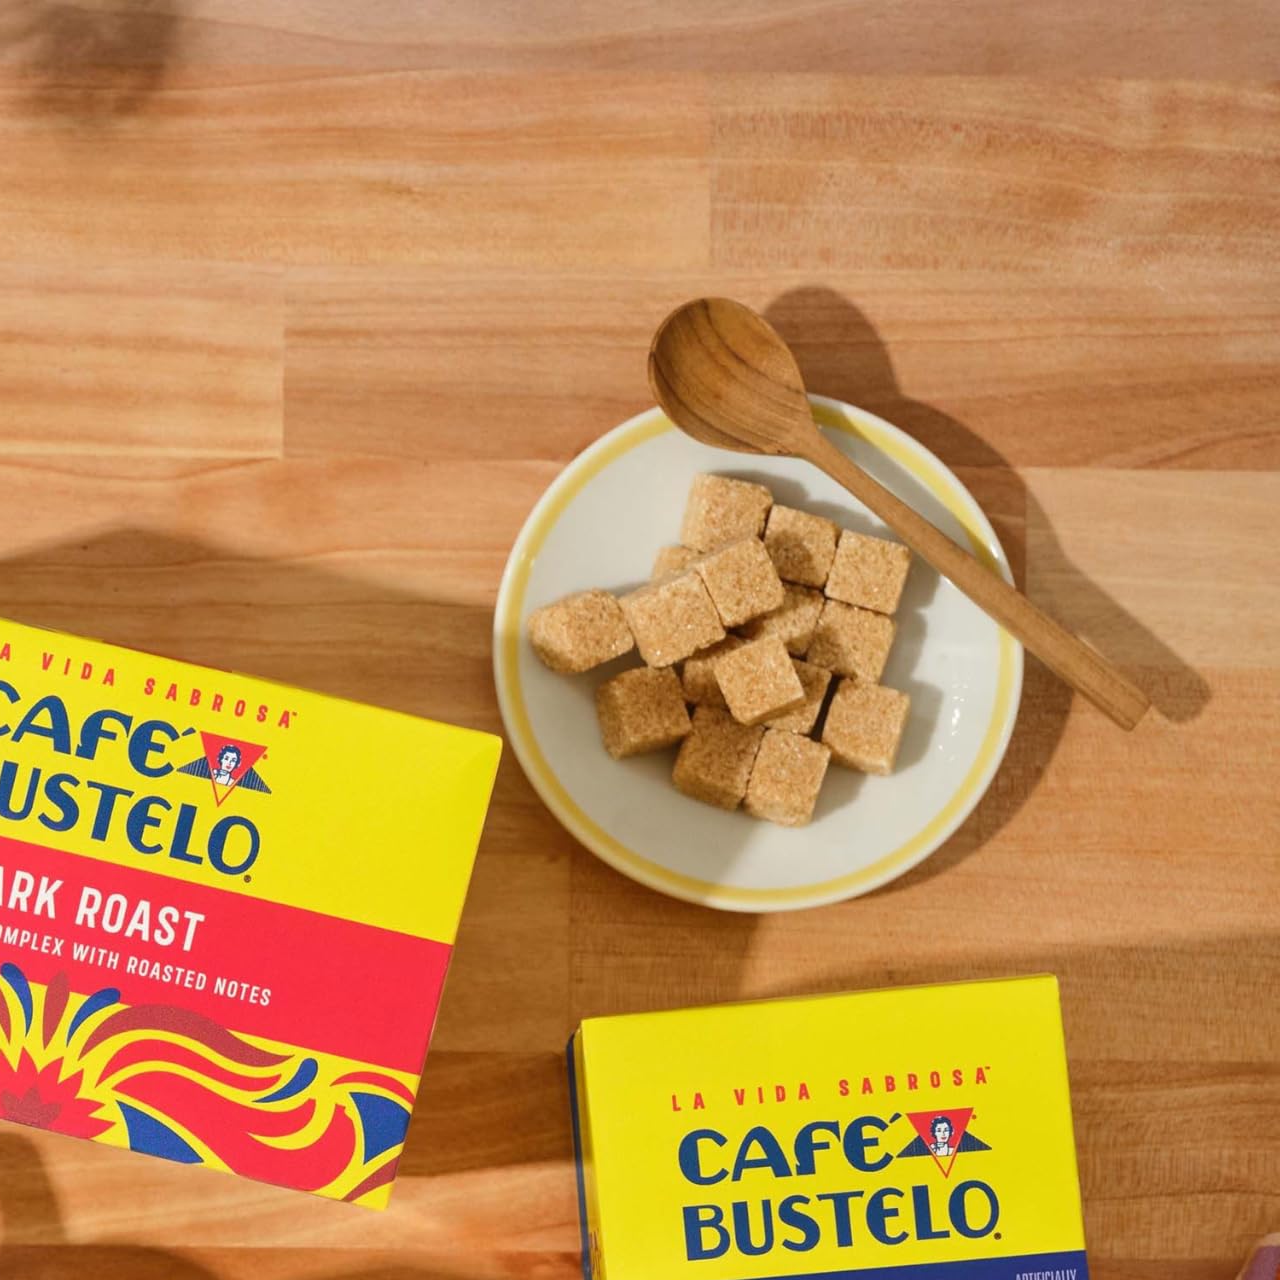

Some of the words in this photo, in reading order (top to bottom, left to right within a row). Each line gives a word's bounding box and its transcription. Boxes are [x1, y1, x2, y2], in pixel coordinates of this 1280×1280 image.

[41, 653, 115, 686] VIDA
[76, 887, 204, 951] ROAST
[74, 943, 119, 969] WITH
[127, 957, 206, 989] ROASTED
[214, 978, 270, 1005] NOTES
[670, 1091, 705, 1112] LA
[733, 1081, 810, 1105] VIDA
